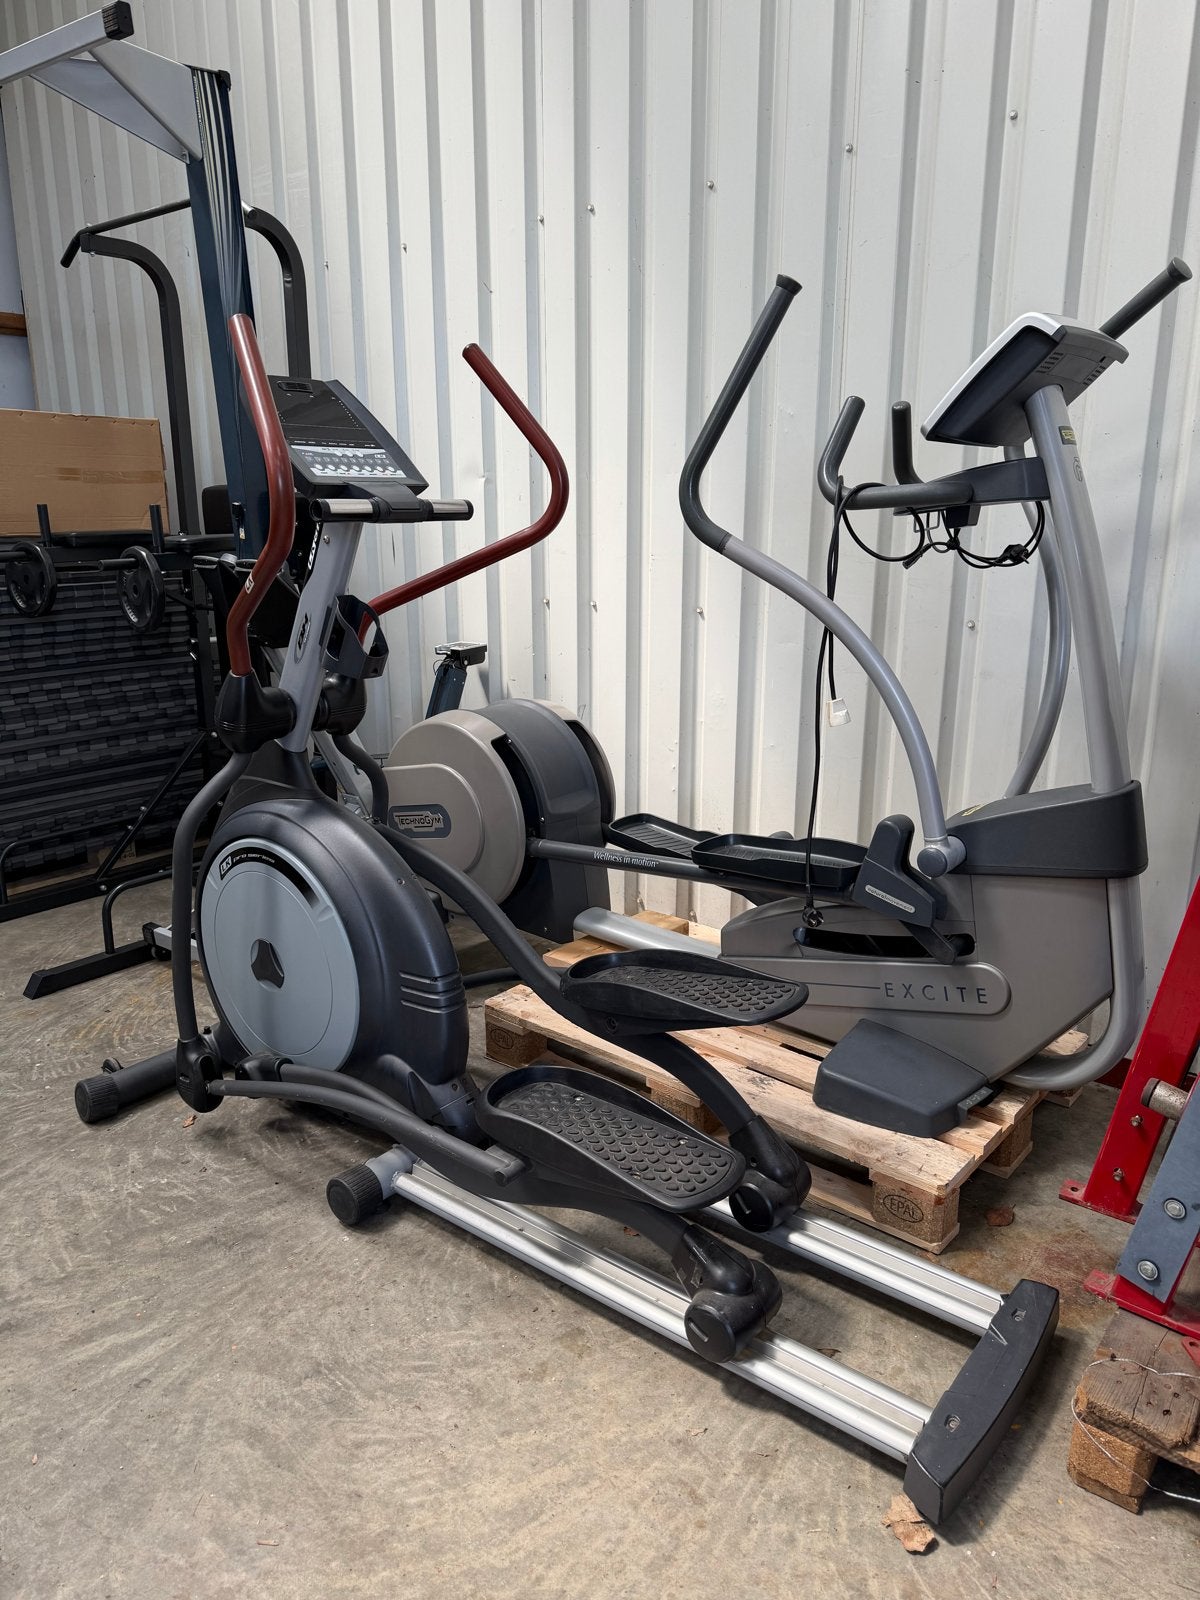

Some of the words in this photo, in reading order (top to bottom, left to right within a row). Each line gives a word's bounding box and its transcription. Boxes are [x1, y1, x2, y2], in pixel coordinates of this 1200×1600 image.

[593, 851, 623, 863] Wellness
[623, 856, 631, 864] in
[884, 982, 988, 1004] EXCITE
[889, 1197, 920, 1221] EPAL
